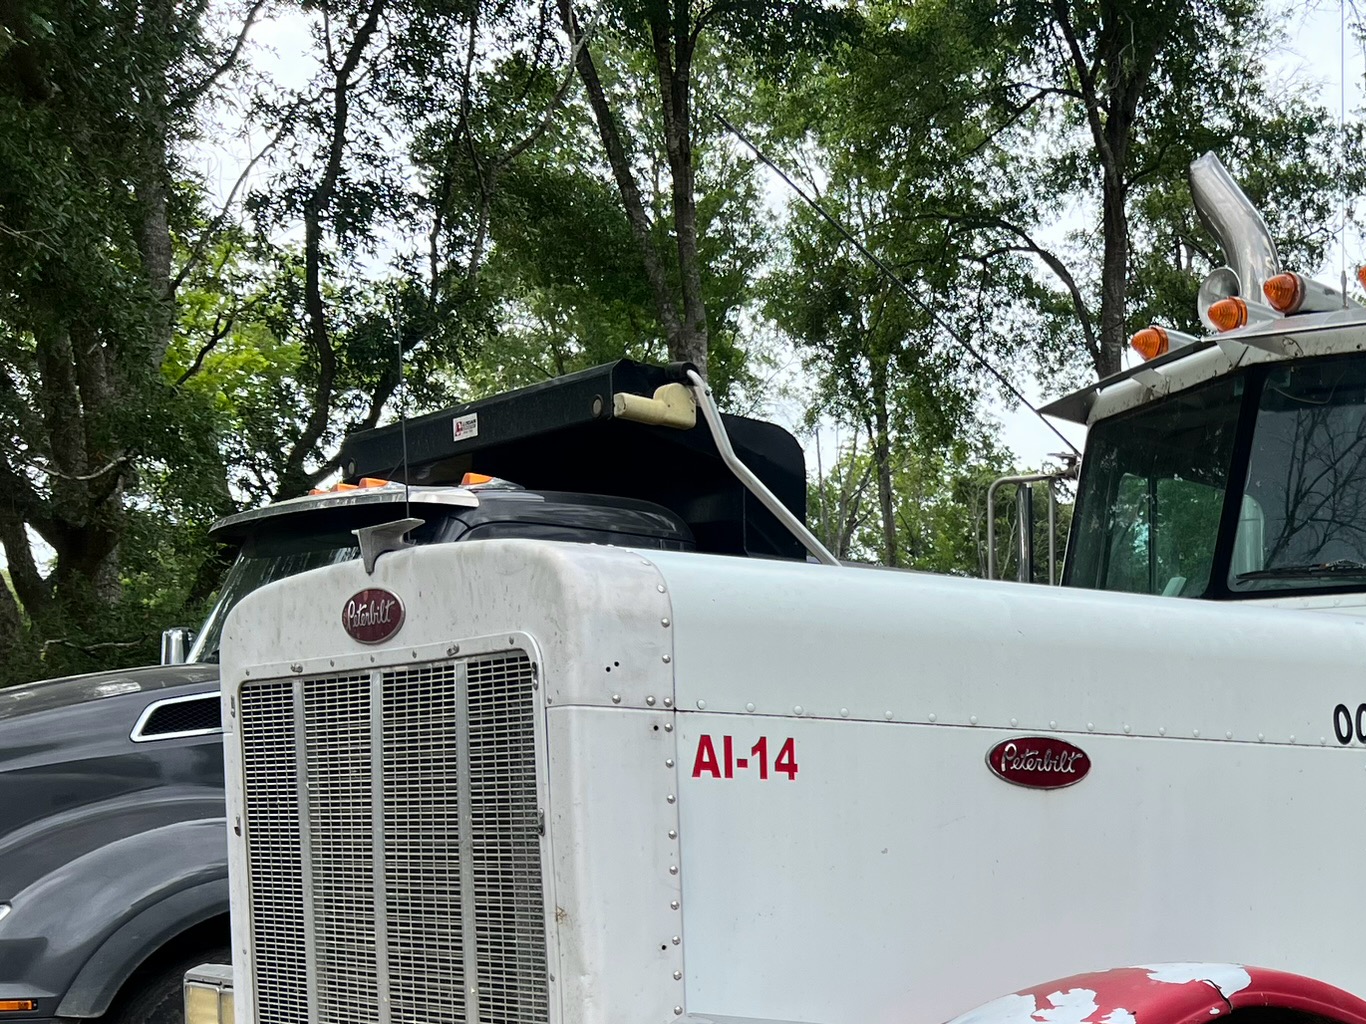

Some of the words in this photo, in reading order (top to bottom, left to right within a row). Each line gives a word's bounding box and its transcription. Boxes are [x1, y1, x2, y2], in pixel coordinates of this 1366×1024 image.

[347, 599, 396, 631] Peterbilt
[691, 733, 799, 781] AI-14
[1001, 742, 1084, 774] Peterbilt
